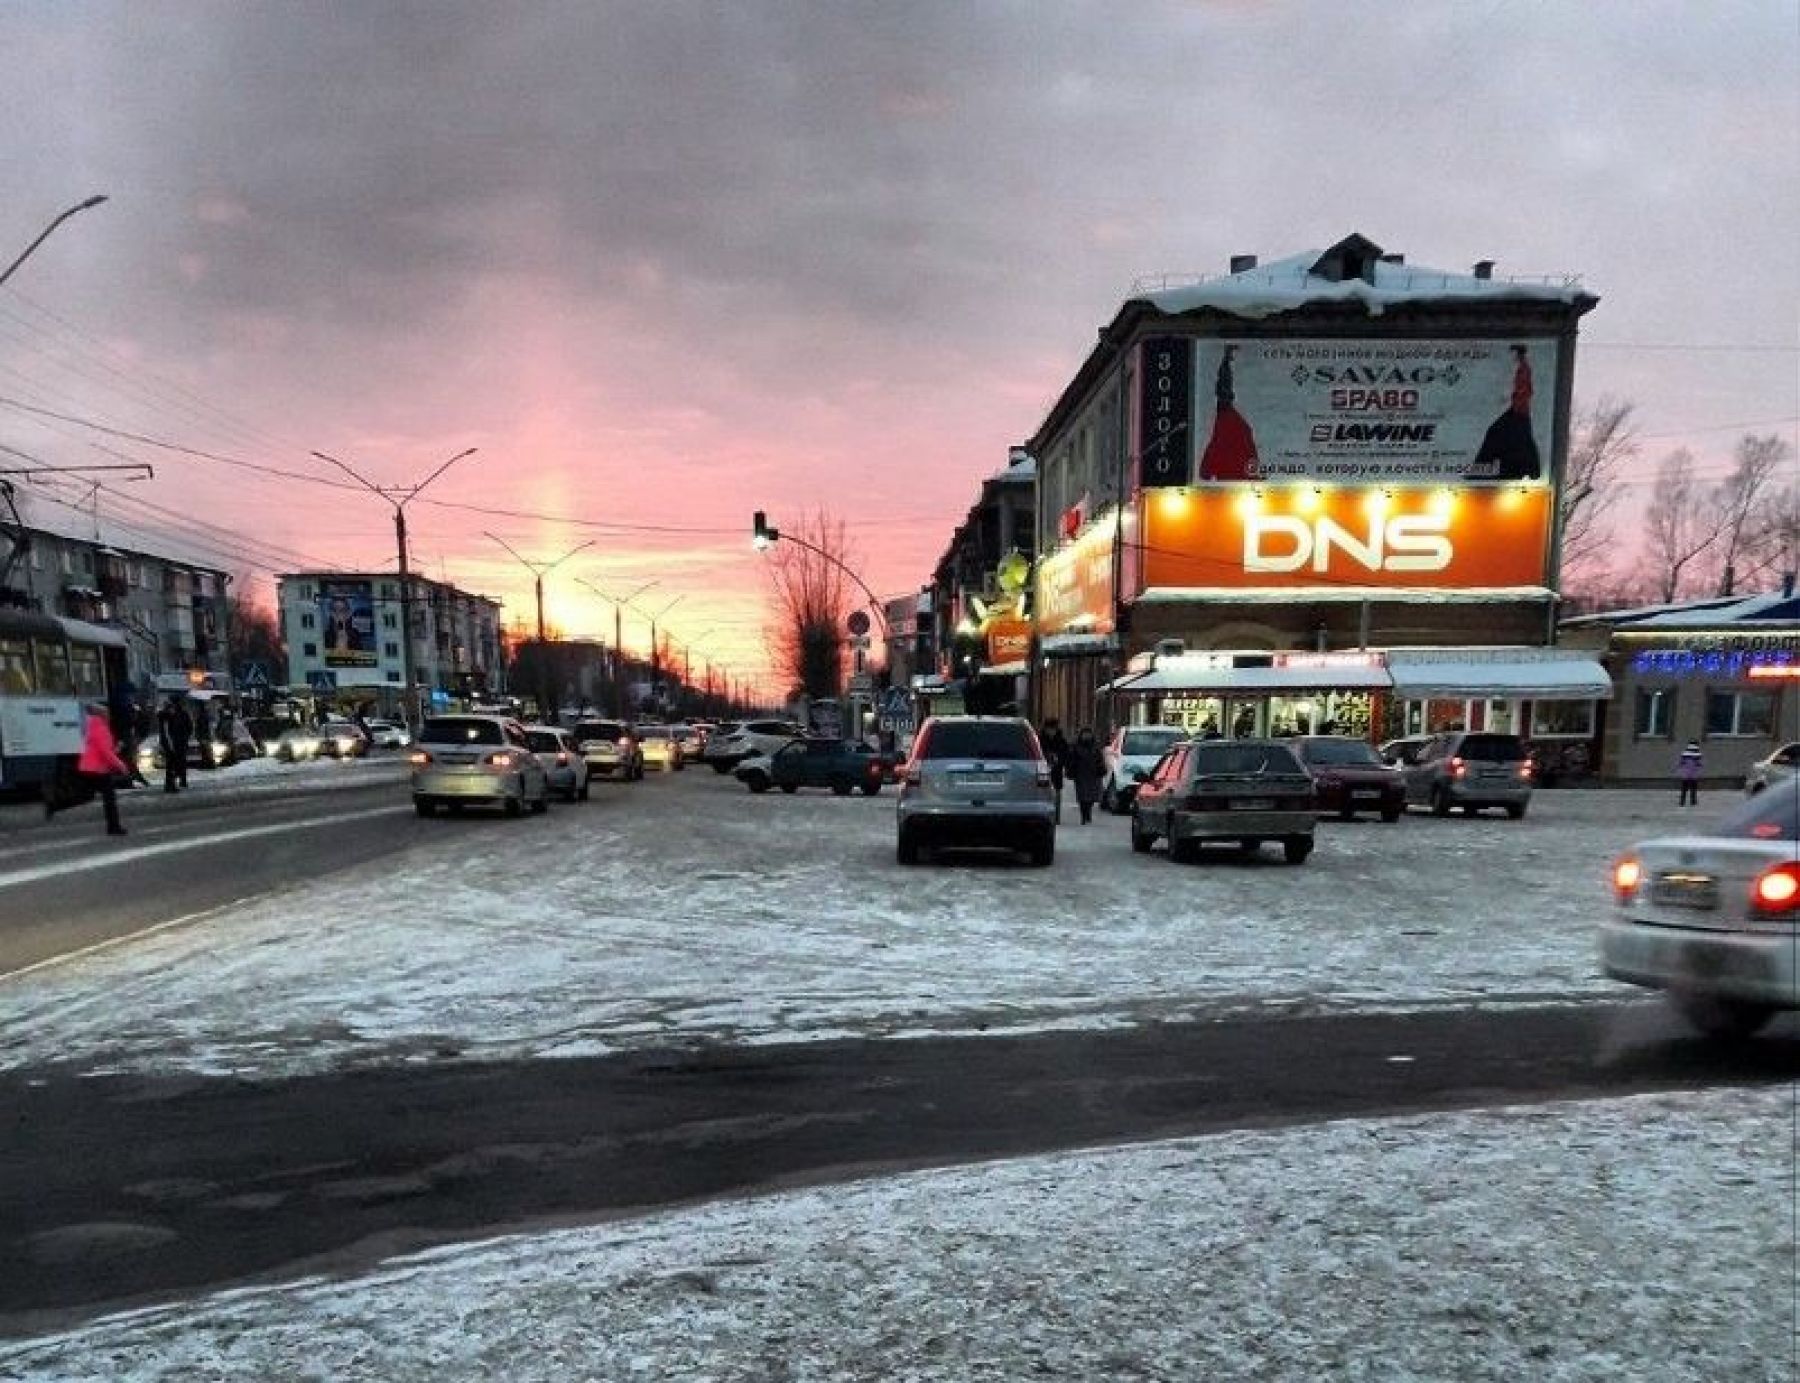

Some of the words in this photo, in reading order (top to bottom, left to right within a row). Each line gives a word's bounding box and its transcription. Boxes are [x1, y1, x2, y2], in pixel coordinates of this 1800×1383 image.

[1156, 352, 1172, 474] ЗОЛОТО
[1335, 423, 1437, 441] LAWINE
[1242, 512, 1454, 574] DNS
